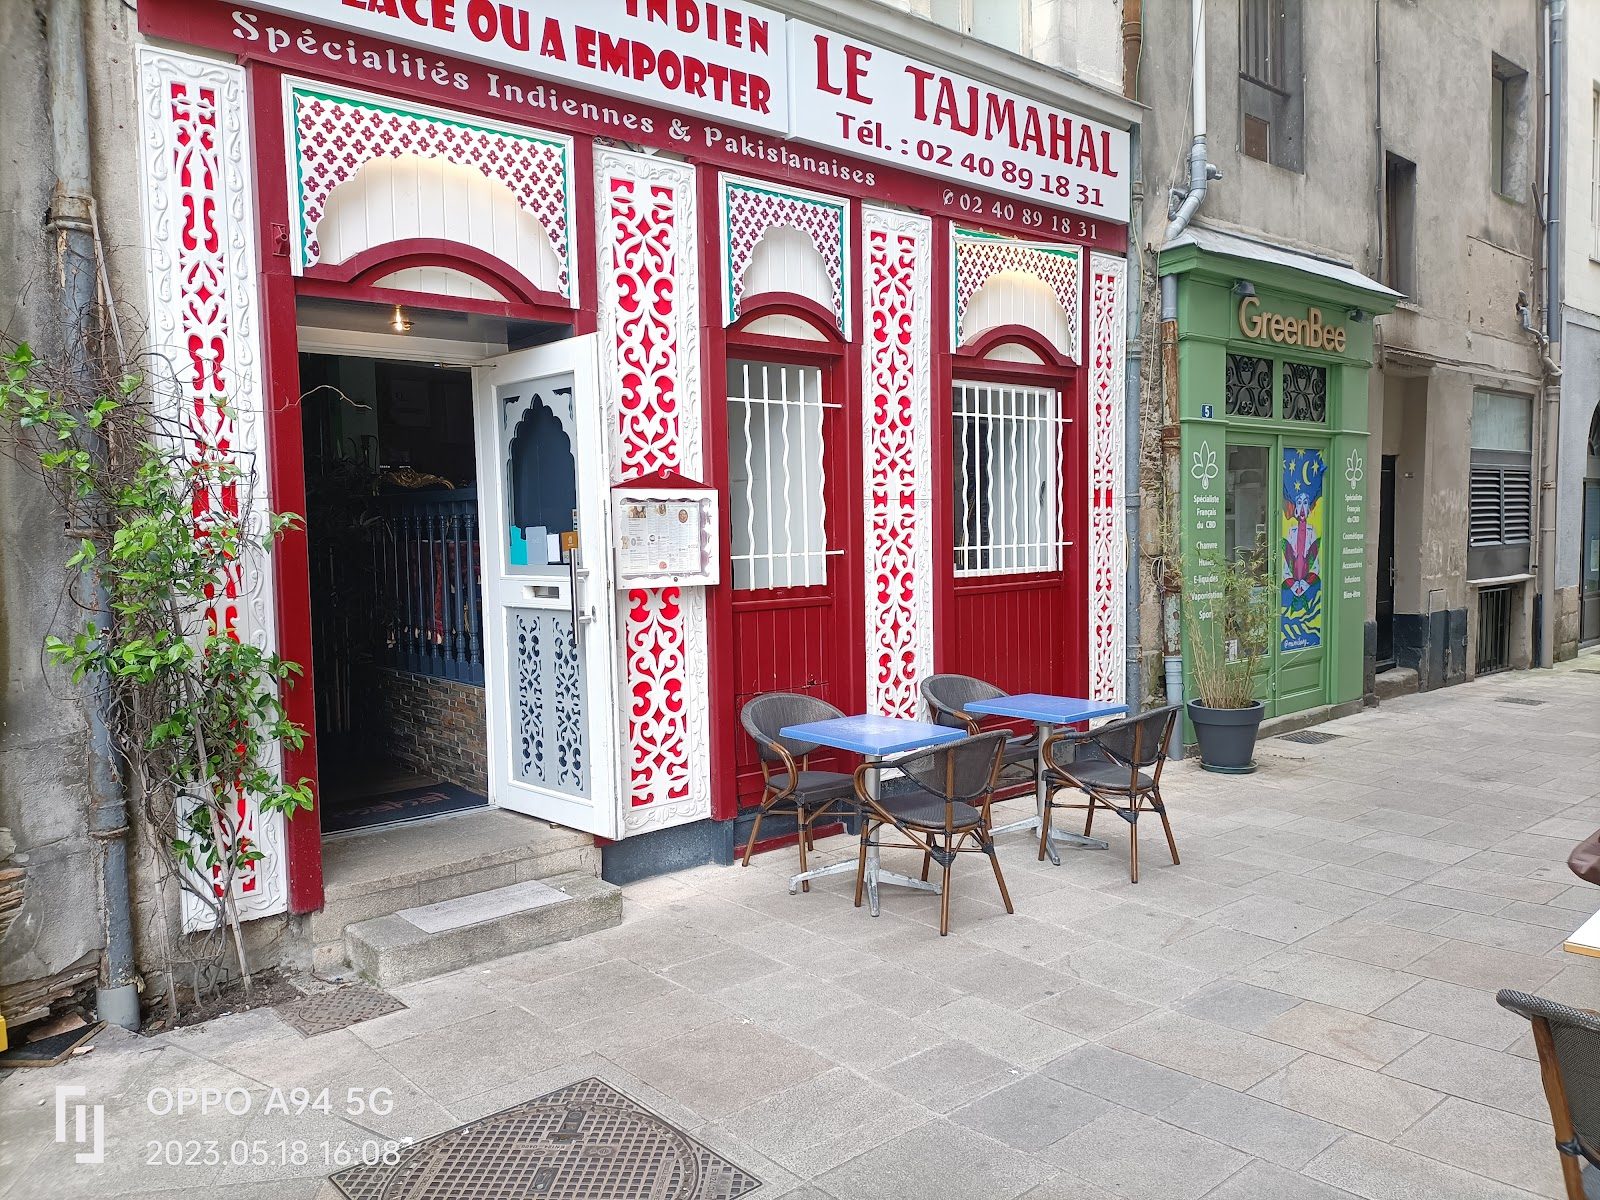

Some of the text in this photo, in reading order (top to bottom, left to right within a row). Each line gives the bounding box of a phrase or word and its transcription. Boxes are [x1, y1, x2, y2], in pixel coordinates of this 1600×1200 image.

[341, 0, 771, 115] CE OU A EMPORTER
[232, 10, 877, 188] Spécialités Indiennes & Pakistanaises
[813, 34, 1119, 178] LE TAJMAHAL
[836, 112, 892, 152] Tél.
[916, 139, 953, 168] 02
[960, 152, 995, 178] 40
[1001, 160, 1034, 190] 89
[1040, 174, 1070, 198] 18
[1076, 183, 1104, 208] 31
[959, 193, 1097, 240] 02 40 89 18 31
[1238, 296, 1347, 353] GreenBee
[1204, 405, 1210, 418] 5
[1196, 520, 1204, 529] du
